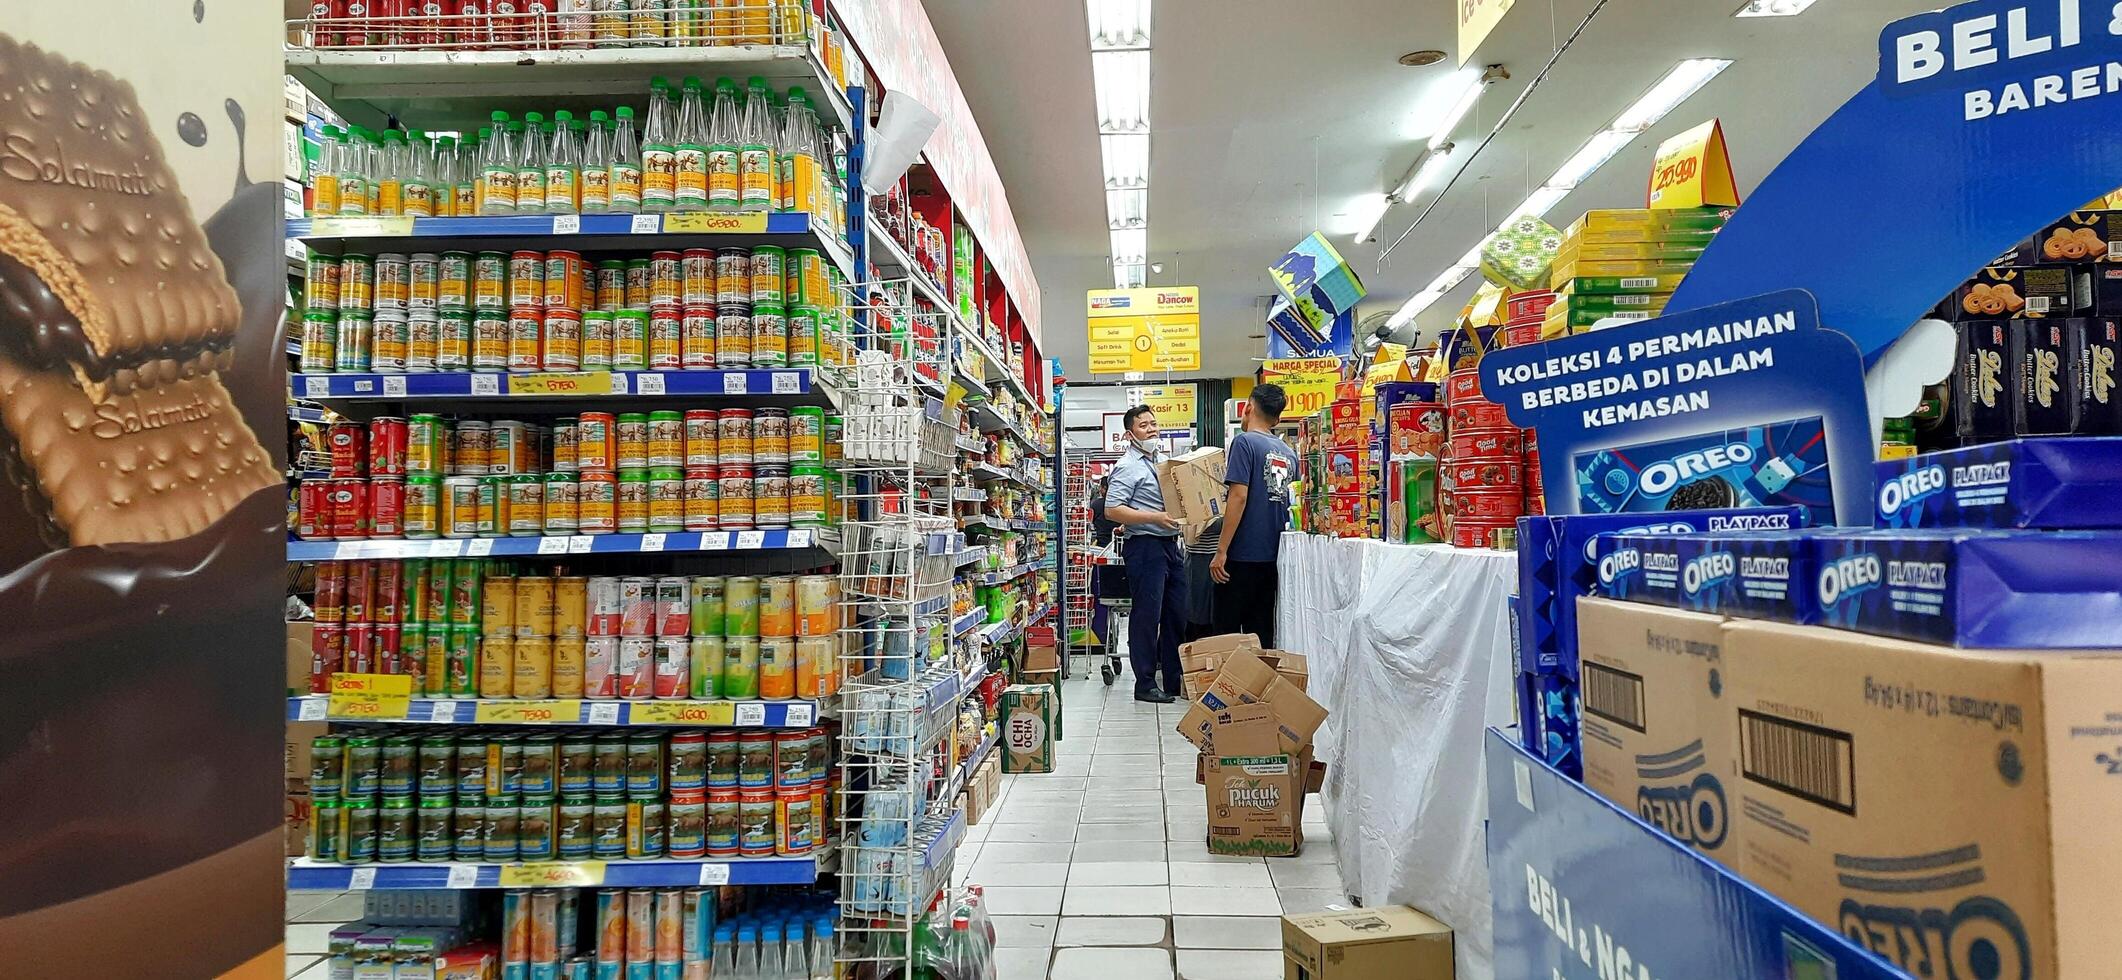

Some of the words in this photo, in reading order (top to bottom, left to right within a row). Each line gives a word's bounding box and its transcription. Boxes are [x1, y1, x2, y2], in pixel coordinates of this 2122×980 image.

[1897, 0, 2081, 84] BELI
[1157, 293, 1194, 305] Dancow
[1497, 350, 1600, 387] KOLEKSI
[1607, 346, 1623, 366] 4
[1629, 310, 1796, 363] PERMAINAN
[1272, 362, 1302, 370] HARGA
[1304, 360, 1338, 370] SPECIAL
[1969, 354, 1977, 376] Butter
[2026, 354, 2034, 377] Butter
[1521, 372, 1639, 411] BERBEDA
[1643, 366, 1670, 388] DI
[1676, 347, 1774, 384] DALAM
[1970, 376, 1978, 404] Cookies
[2026, 377, 2034, 404] Cookies
[2083, 372, 2091, 400] Cookies
[1149, 404, 1173, 413] Kasir
[1176, 403, 1189, 412] 13
[1582, 390, 1710, 430] KEMASAN
[1476, 438, 1496, 449] Good
[1480, 443, 1497, 453] Time
[1459, 468, 1476, 478] Good
[1461, 474, 1476, 483] Time
[1639, 442, 1753, 496] OREO
[1952, 461, 2011, 488] PLAYPACK
[1880, 466, 1946, 516] OREO
[1709, 514, 1790, 532] PLAYPACK
[1600, 548, 1640, 584] OREO
[1643, 553, 1680, 572] PLAYPACK
[1683, 552, 1735, 595] OREO
[1740, 557, 1790, 580] PLAYPACK
[1887, 561, 1948, 590] PLAYPACK
[1819, 555, 1882, 606] OREO
[1013, 720, 1023, 748] ICHI
[1024, 719, 1033, 748] OCHA
[1230, 784, 1280, 807] pucuk
[1238, 799, 1276, 808] HARUM
[1638, 774, 1728, 850] OREO
[1526, 863, 1574, 951] BELI
[1579, 928, 1591, 968] &
[1594, 924, 1650, 980] NG
